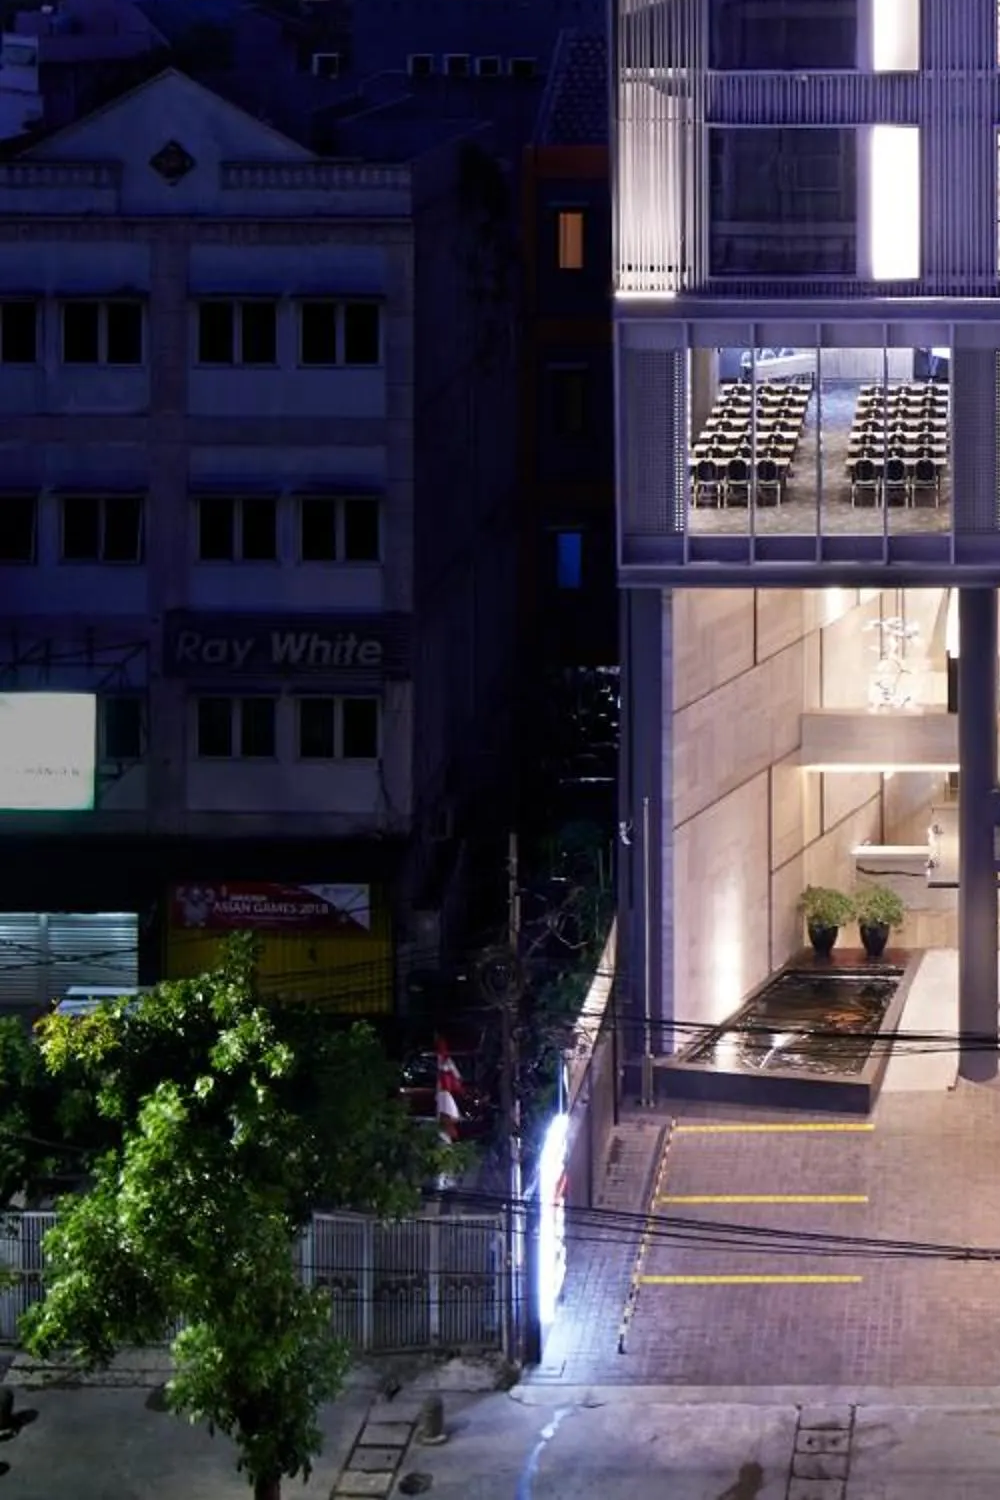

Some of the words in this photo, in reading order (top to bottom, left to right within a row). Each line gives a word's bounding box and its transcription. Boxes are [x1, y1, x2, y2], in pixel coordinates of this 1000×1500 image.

[175, 629, 256, 669] Ray
[270, 629, 384, 666] White
[212, 901, 251, 915] ASIAN
